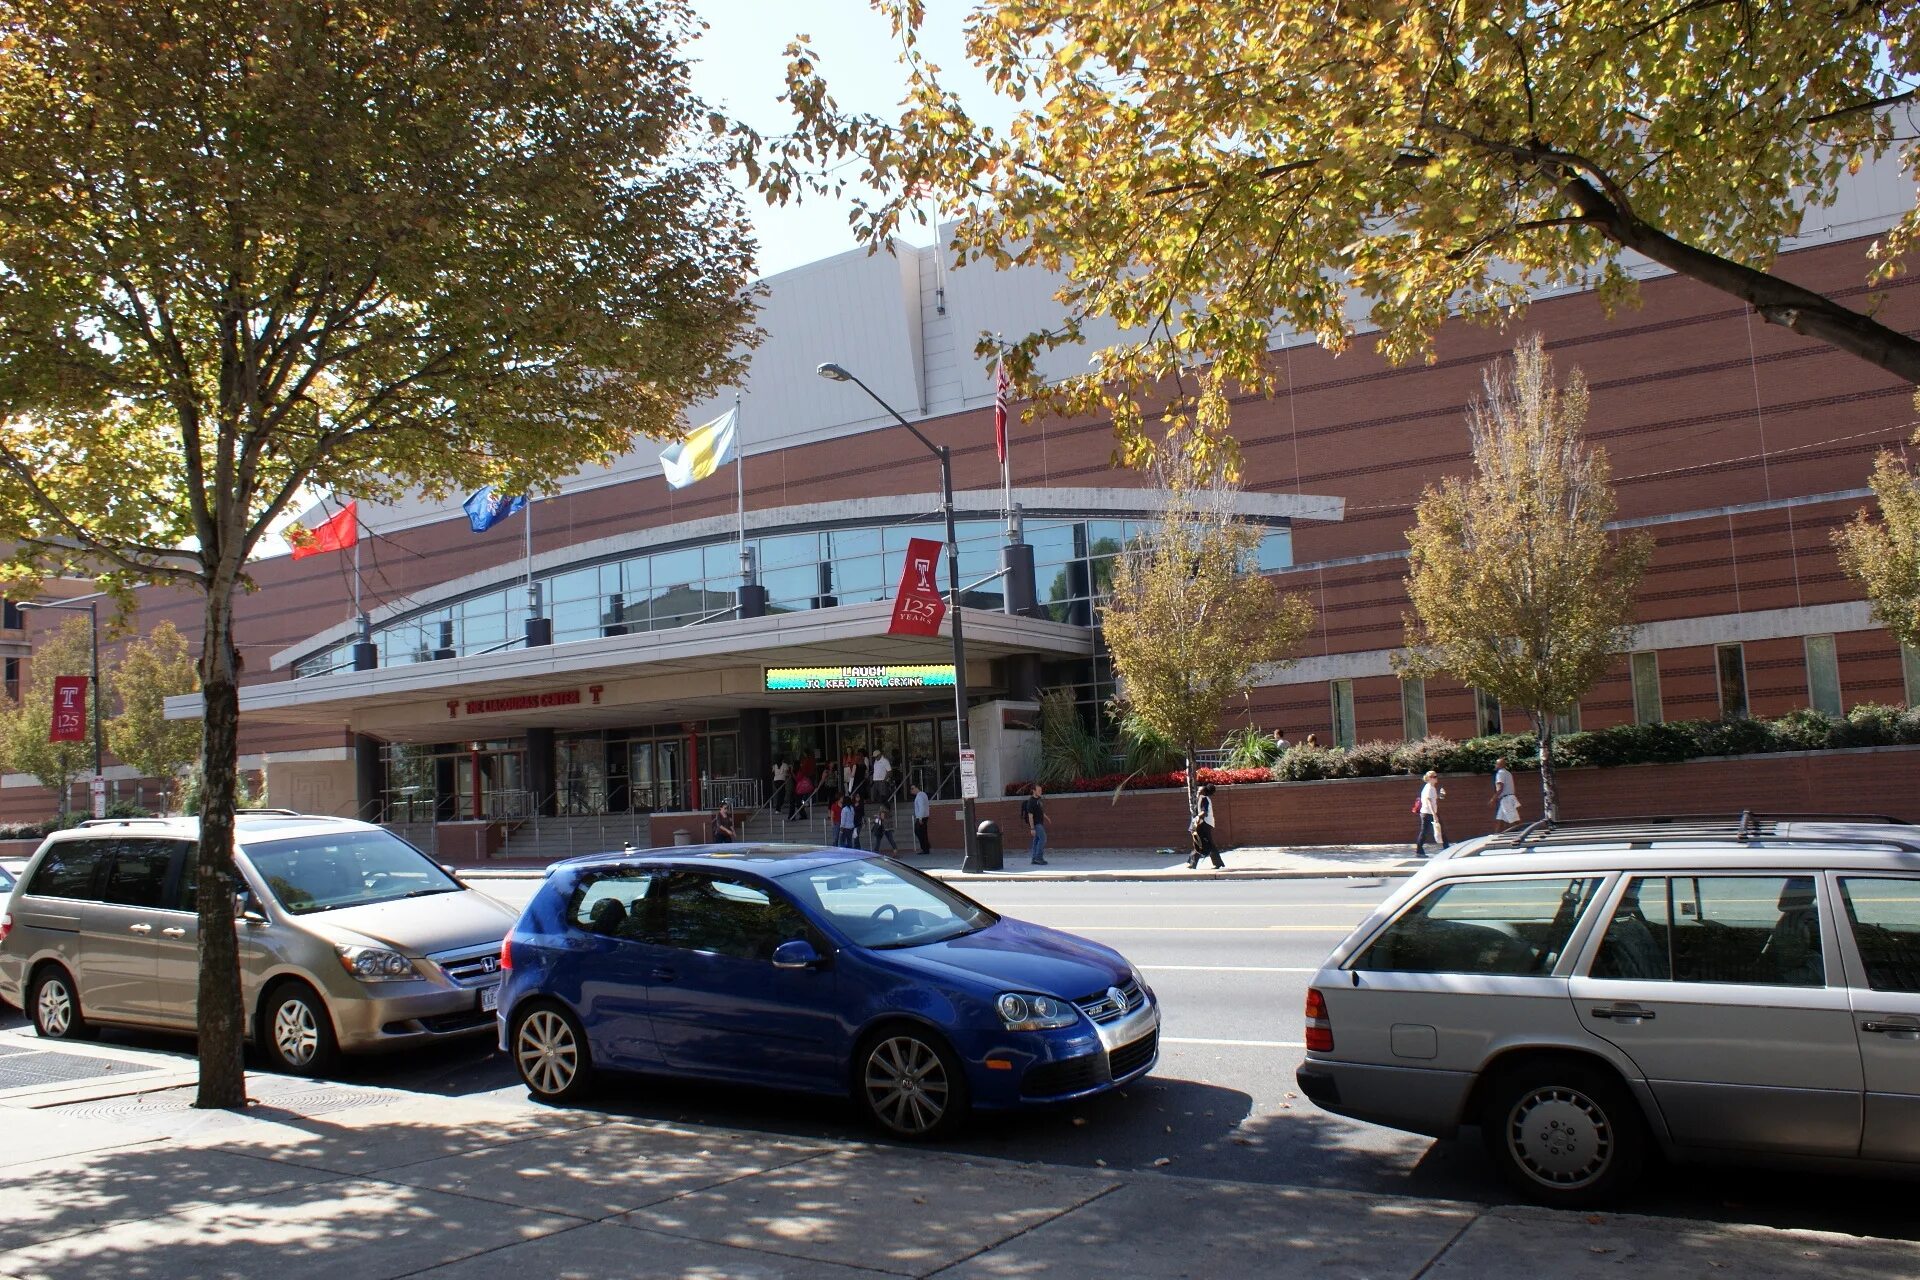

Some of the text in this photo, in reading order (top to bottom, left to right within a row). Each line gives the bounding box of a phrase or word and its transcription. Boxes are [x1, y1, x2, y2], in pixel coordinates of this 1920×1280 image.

[914, 558, 931, 592] T
[901, 597, 937, 618] 125
[900, 613, 933, 625] YEARS
[843, 666, 885, 677] LAUGH
[807, 677, 923, 688] TO KEEP FROM CRYING
[465, 700, 484, 714] THE
[541, 690, 580, 707] CENTER
[58, 714, 79, 728] 125
